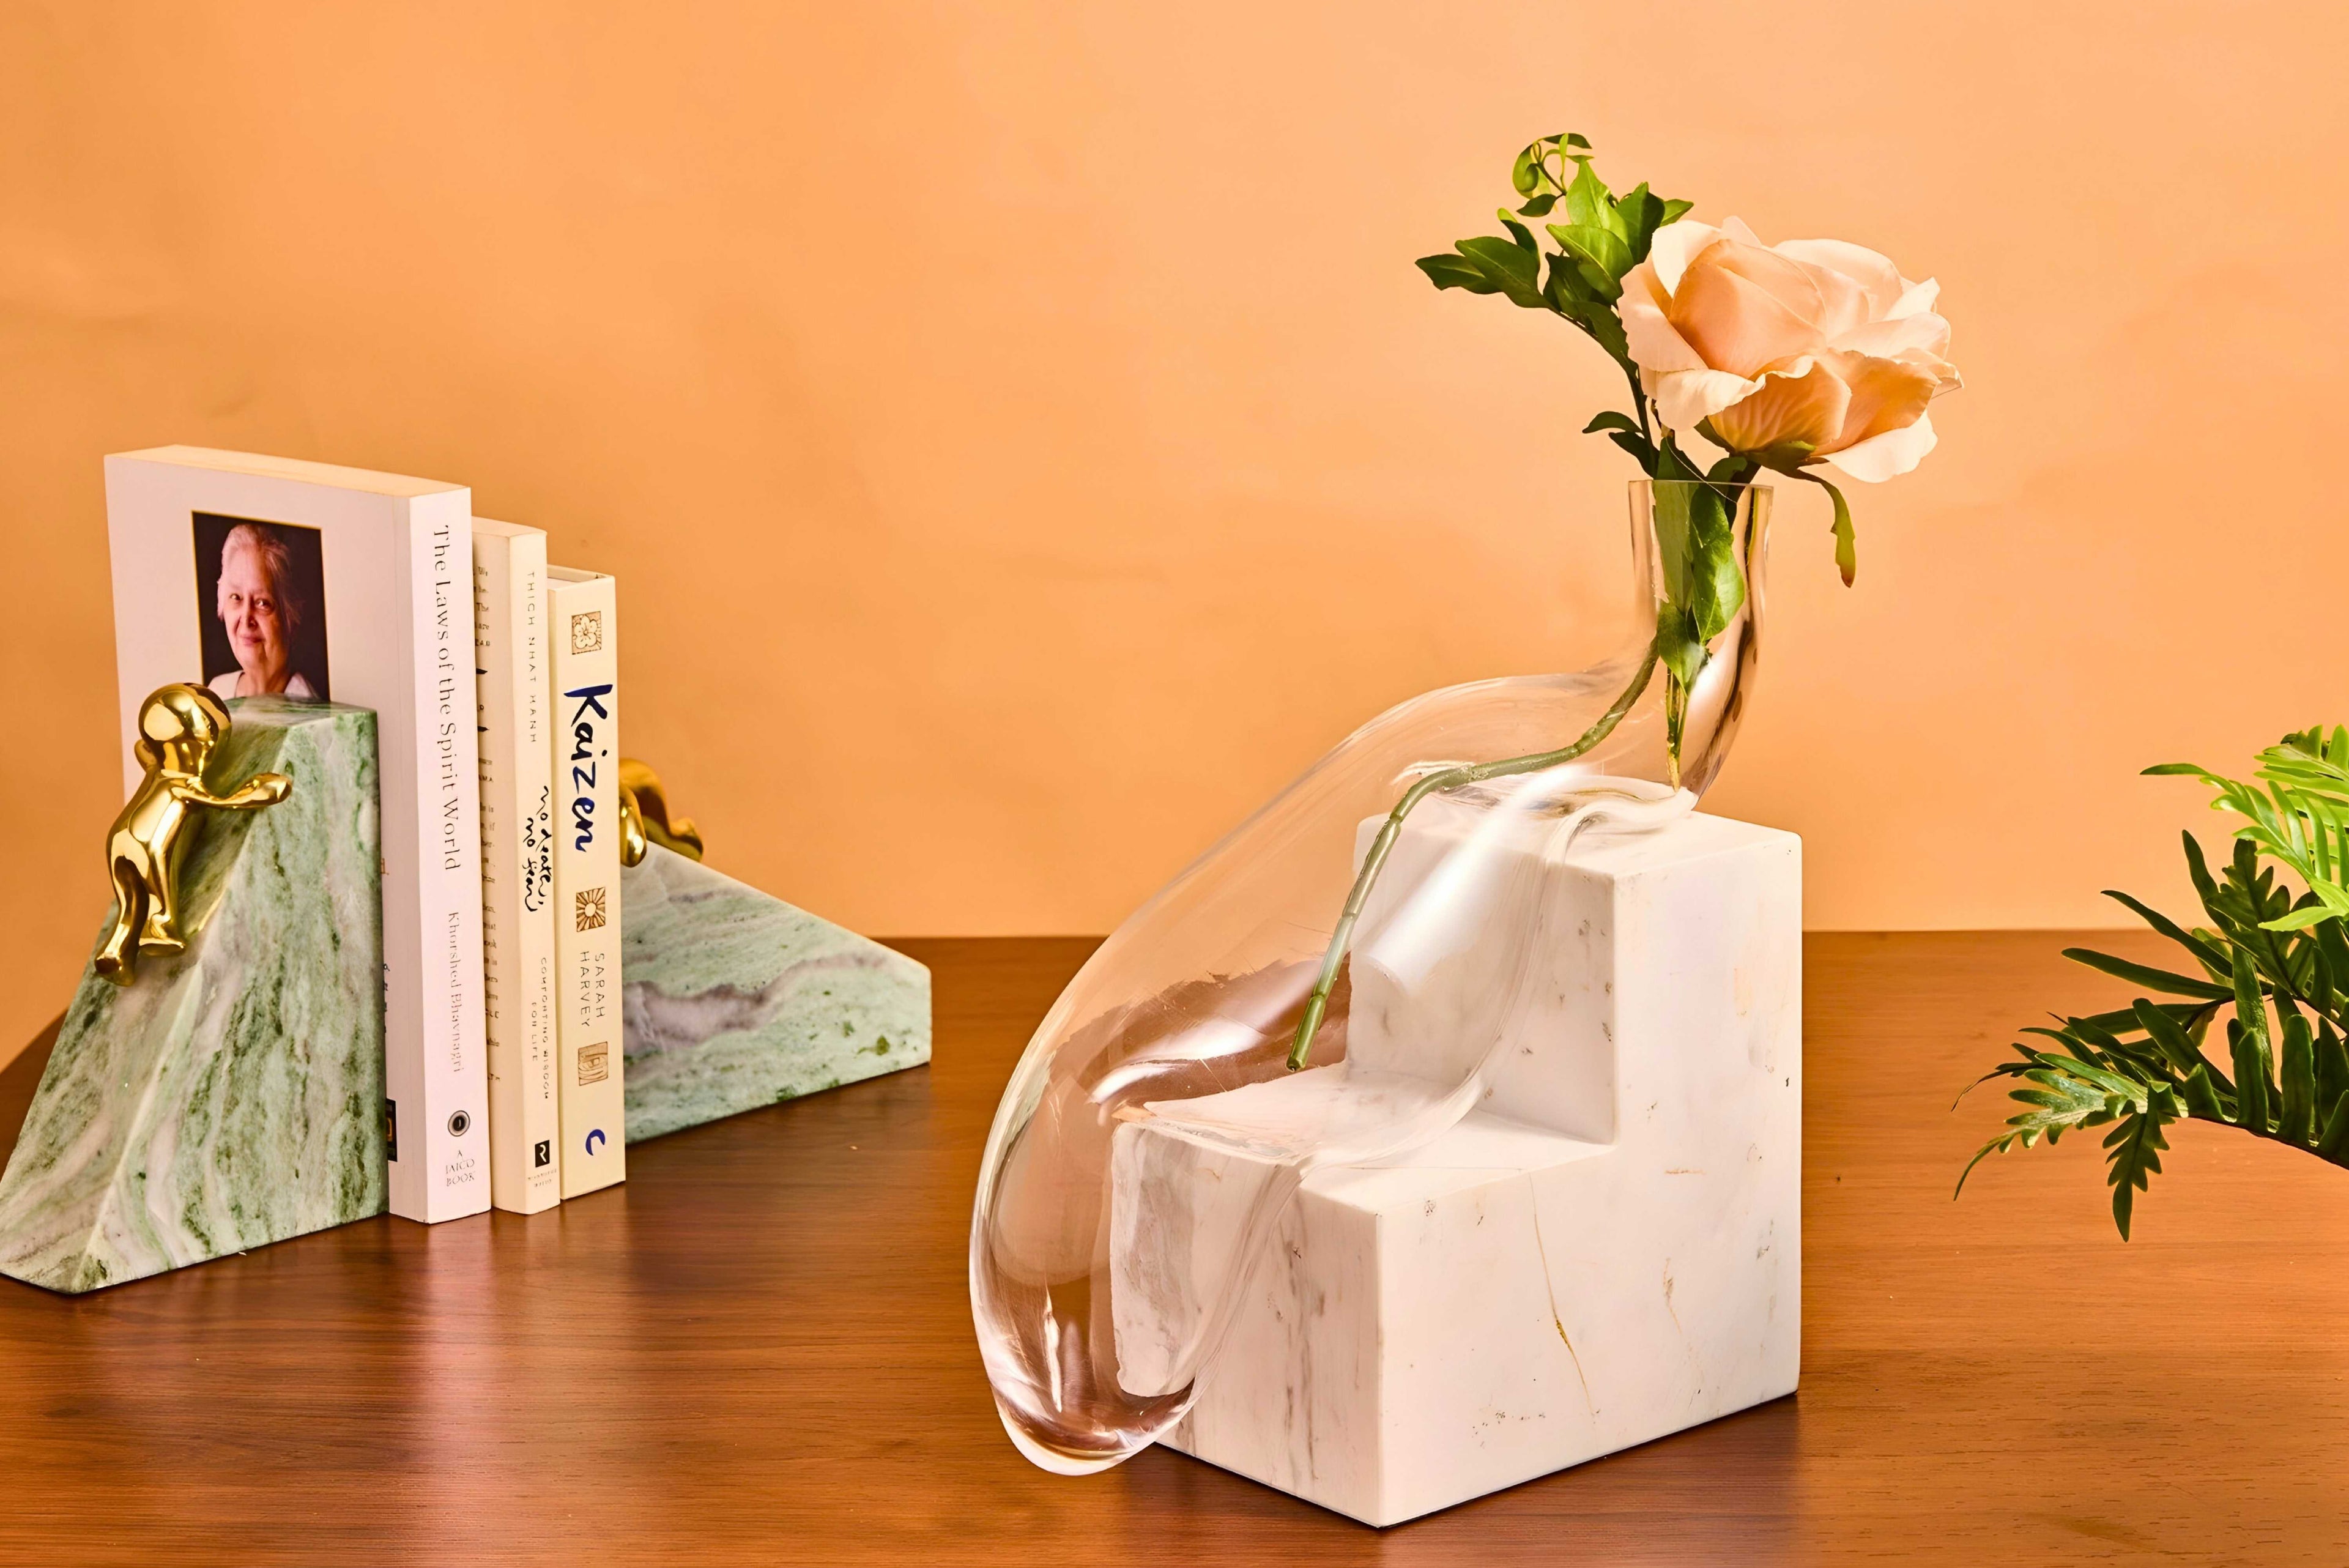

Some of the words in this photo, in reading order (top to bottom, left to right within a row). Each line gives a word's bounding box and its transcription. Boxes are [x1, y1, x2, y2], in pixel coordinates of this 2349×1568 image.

[434, 525, 450, 571] The
[436, 581, 451, 641] Laws
[438, 648, 455, 671] of
[439, 678, 456, 715] the
[437, 723, 458, 791] Spirit
[563, 684, 613, 852] Kaizen
[443, 796, 461, 870] World
[448, 912, 461, 988] Khorshed
[580, 951, 591, 1027] HARVEY
[595, 953, 605, 1019] SARAH
